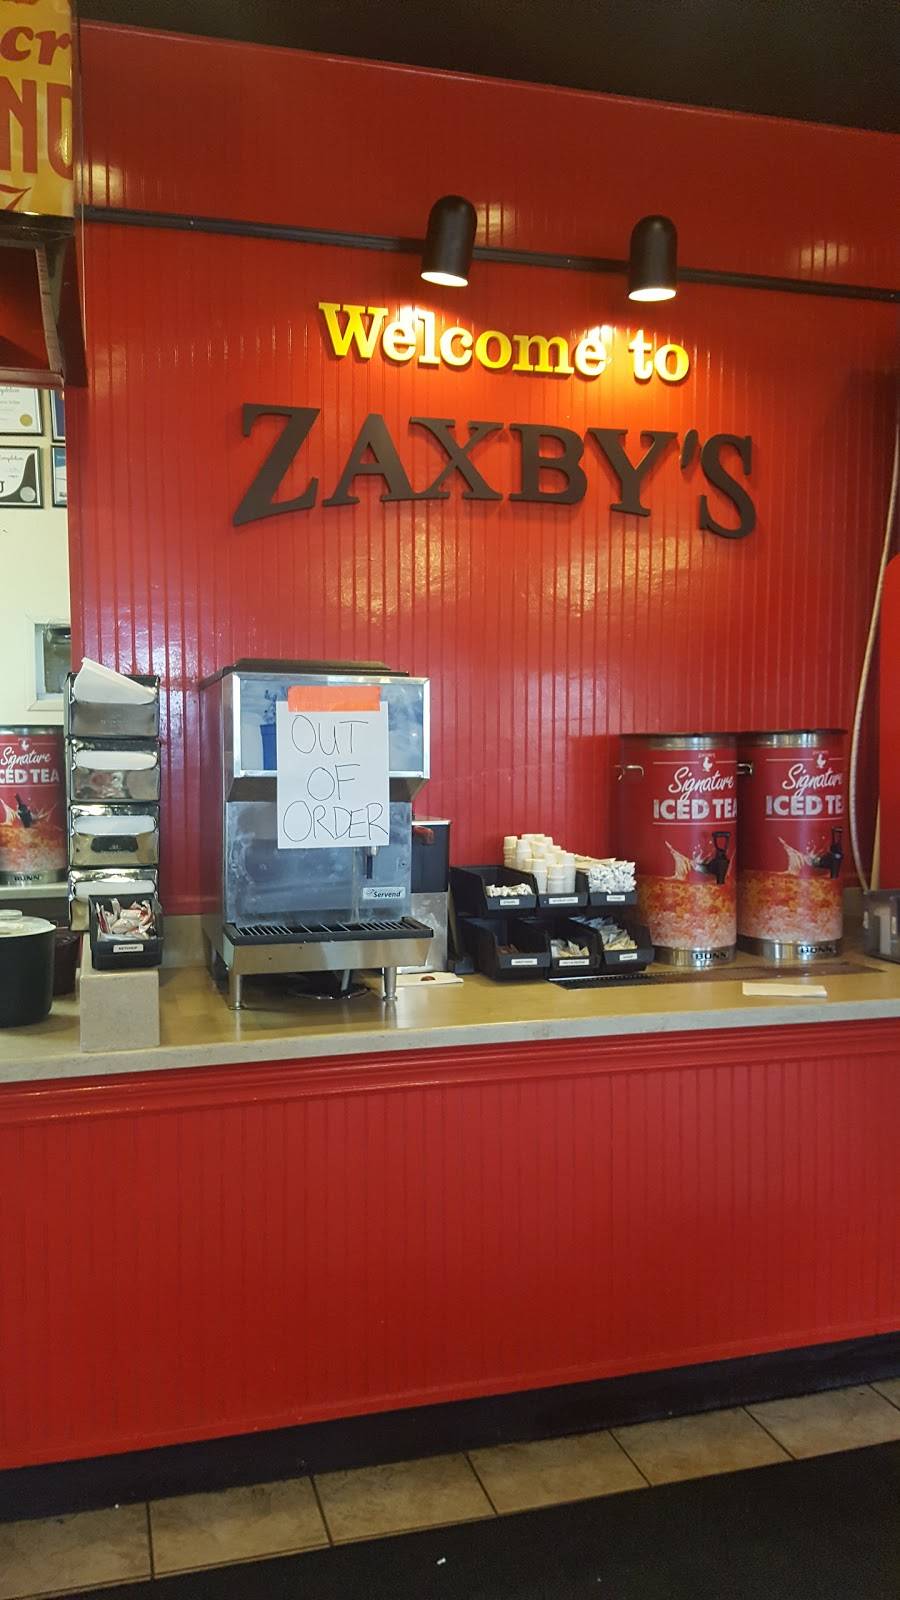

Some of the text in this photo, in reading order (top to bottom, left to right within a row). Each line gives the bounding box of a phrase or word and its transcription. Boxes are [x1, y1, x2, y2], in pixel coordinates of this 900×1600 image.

[318, 301, 690, 383] Welcome to
[233, 403, 757, 539] ZAXBY'S
[291, 714, 369, 756] OUT
[0, 746, 51, 770] Signature
[30, 768, 60, 784] TEA
[306, 763, 361, 801] OF
[668, 766, 734, 800] Signature
[283, 800, 389, 843] ORDER
[653, 799, 710, 820] ICED
[765, 795, 823, 816] ICED
[373, 889, 402, 898] Servend
